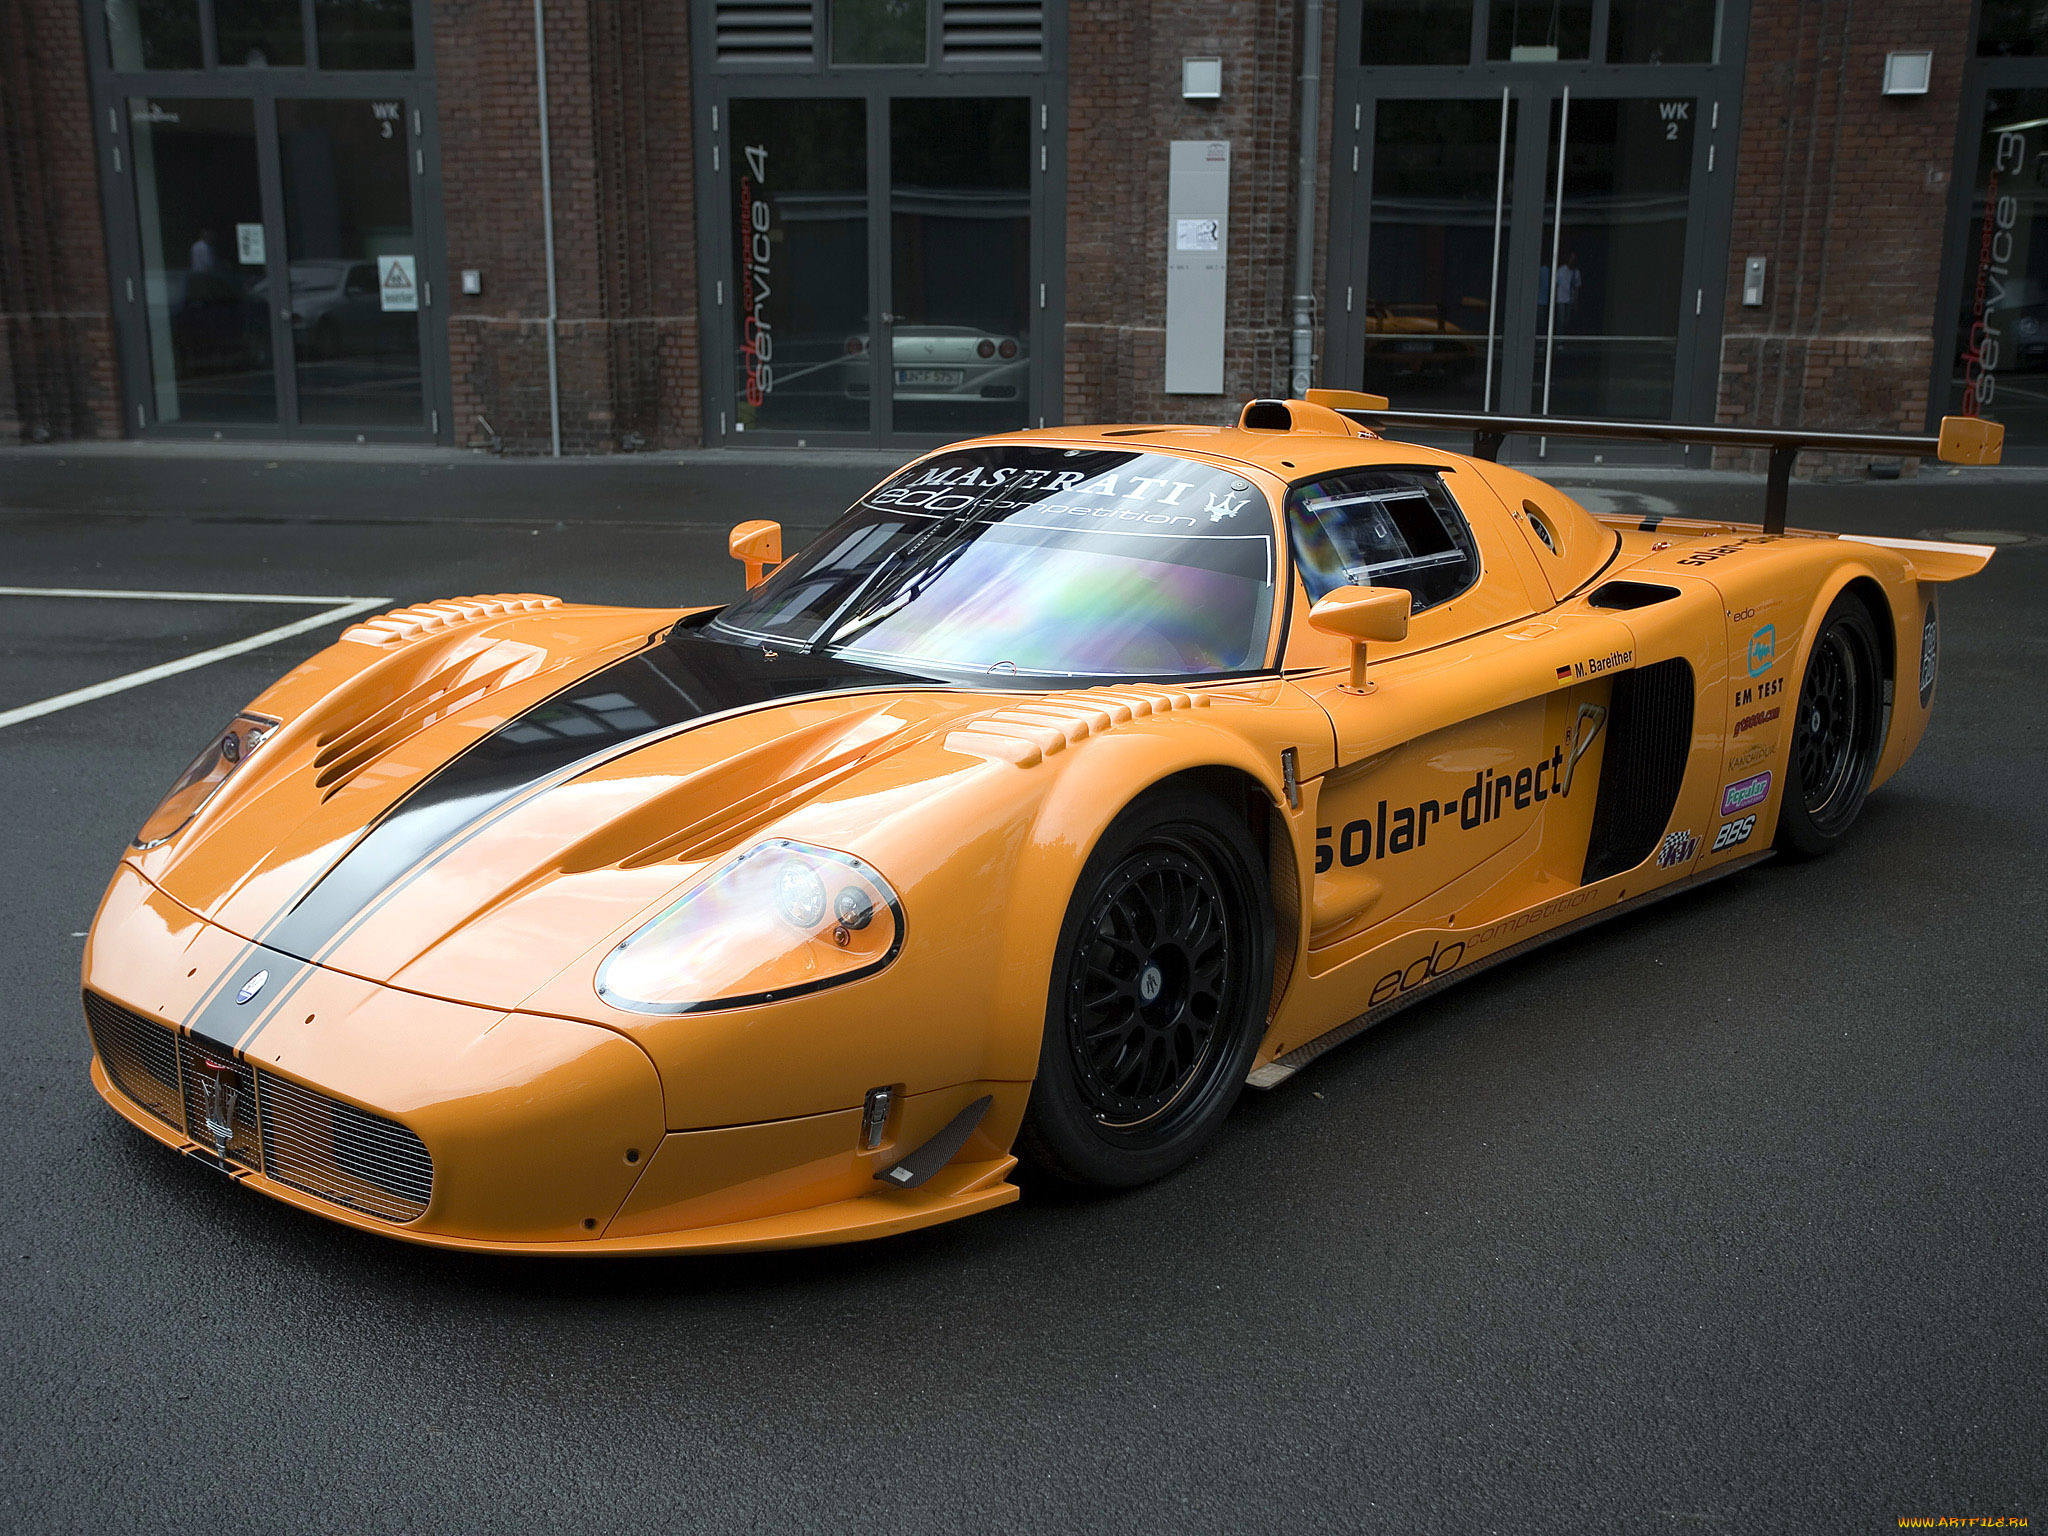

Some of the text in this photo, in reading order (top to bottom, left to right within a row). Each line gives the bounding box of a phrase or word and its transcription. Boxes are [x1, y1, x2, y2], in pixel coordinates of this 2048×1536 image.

[371, 101, 400, 120] WK
[1659, 102, 1689, 120] WK
[380, 120, 393, 139] 3
[1666, 121, 1679, 140] 2
[744, 144, 773, 393] service 4
[1975, 132, 2026, 405] service 3
[872, 487, 976, 511] edo
[905, 466, 1194, 506] MASERATI
[1733, 607, 1755, 622] edo
[1574, 650, 1633, 679] M. Bareither
[1735, 677, 1784, 707] EM TEST
[1724, 779, 1768, 808] Popular
[1315, 745, 1563, 874] solar-direct
[1711, 814, 1757, 855] BBS
[1368, 888, 1599, 1008] edo competition
